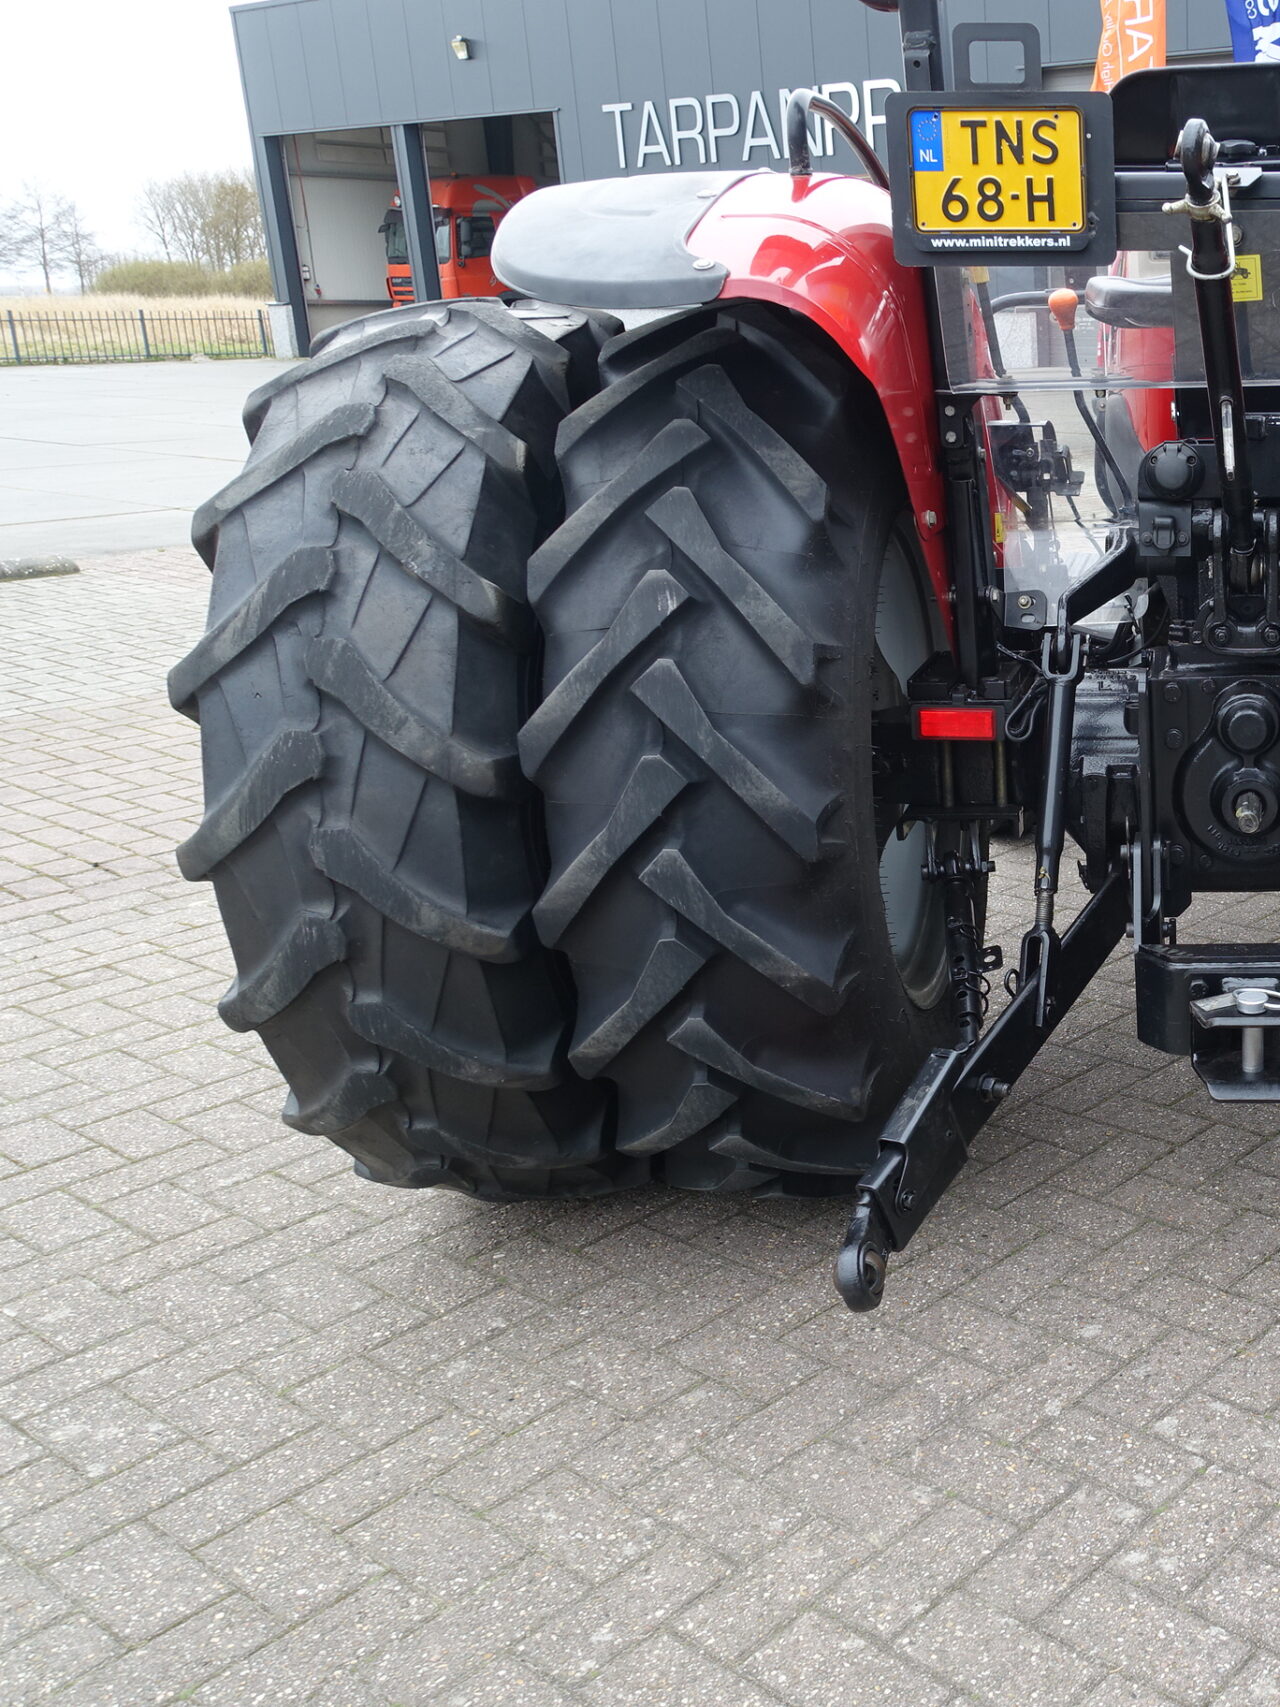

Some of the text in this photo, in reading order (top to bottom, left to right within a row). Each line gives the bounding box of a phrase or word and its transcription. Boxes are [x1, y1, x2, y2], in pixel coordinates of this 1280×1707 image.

[919, 149, 938, 162] NL
[960, 119, 1059, 165] TNS
[941, 177, 1056, 222] 68-H
[931, 235, 1071, 248] www.minitrekkers.nl
